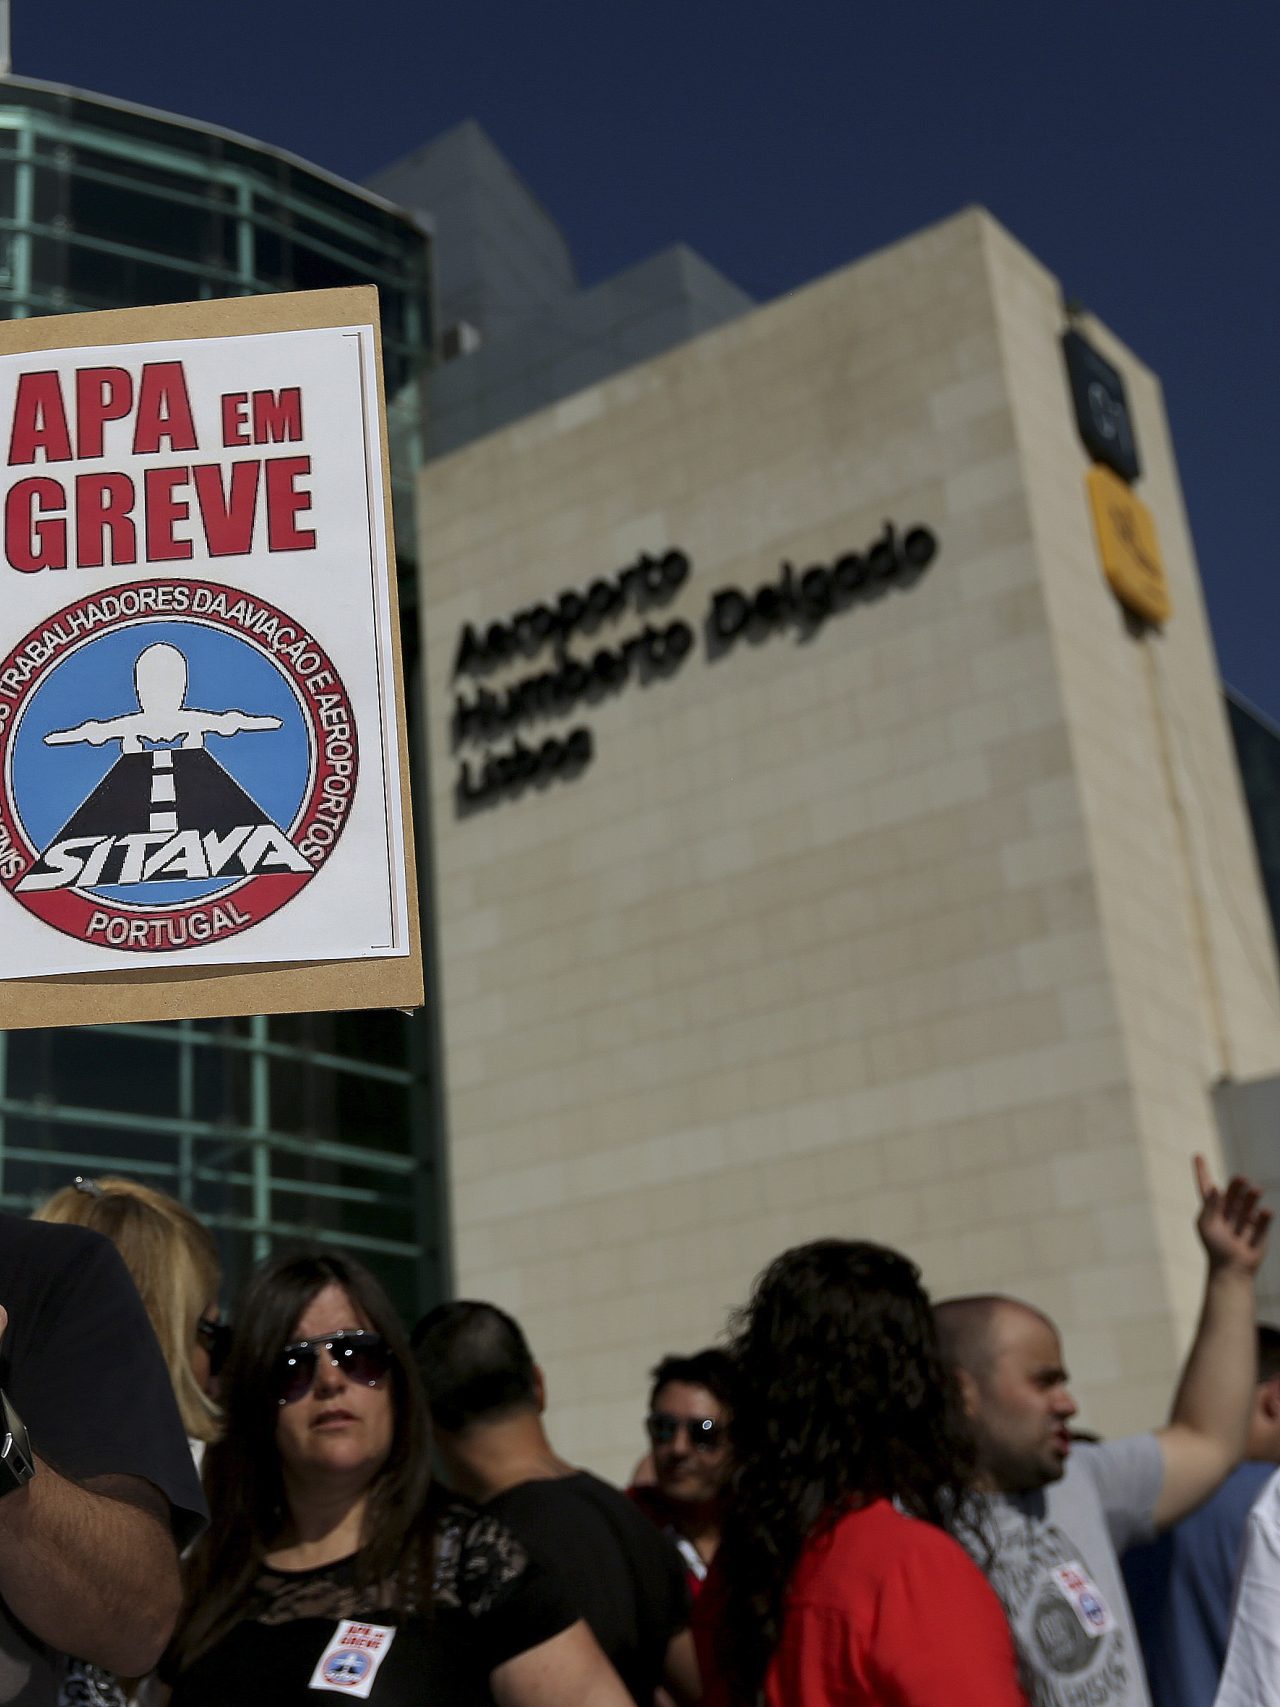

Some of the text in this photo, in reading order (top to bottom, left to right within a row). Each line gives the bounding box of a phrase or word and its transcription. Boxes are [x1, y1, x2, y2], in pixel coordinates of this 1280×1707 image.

[7, 360, 303, 466] APA EM
[4, 455, 317, 574] GREVE
[304, 669, 336, 695] E
[298, 691, 353, 862] AEROPORTOS
[13, 824, 316, 893] SITAVA
[84, 900, 251, 946] PORTUGAL
